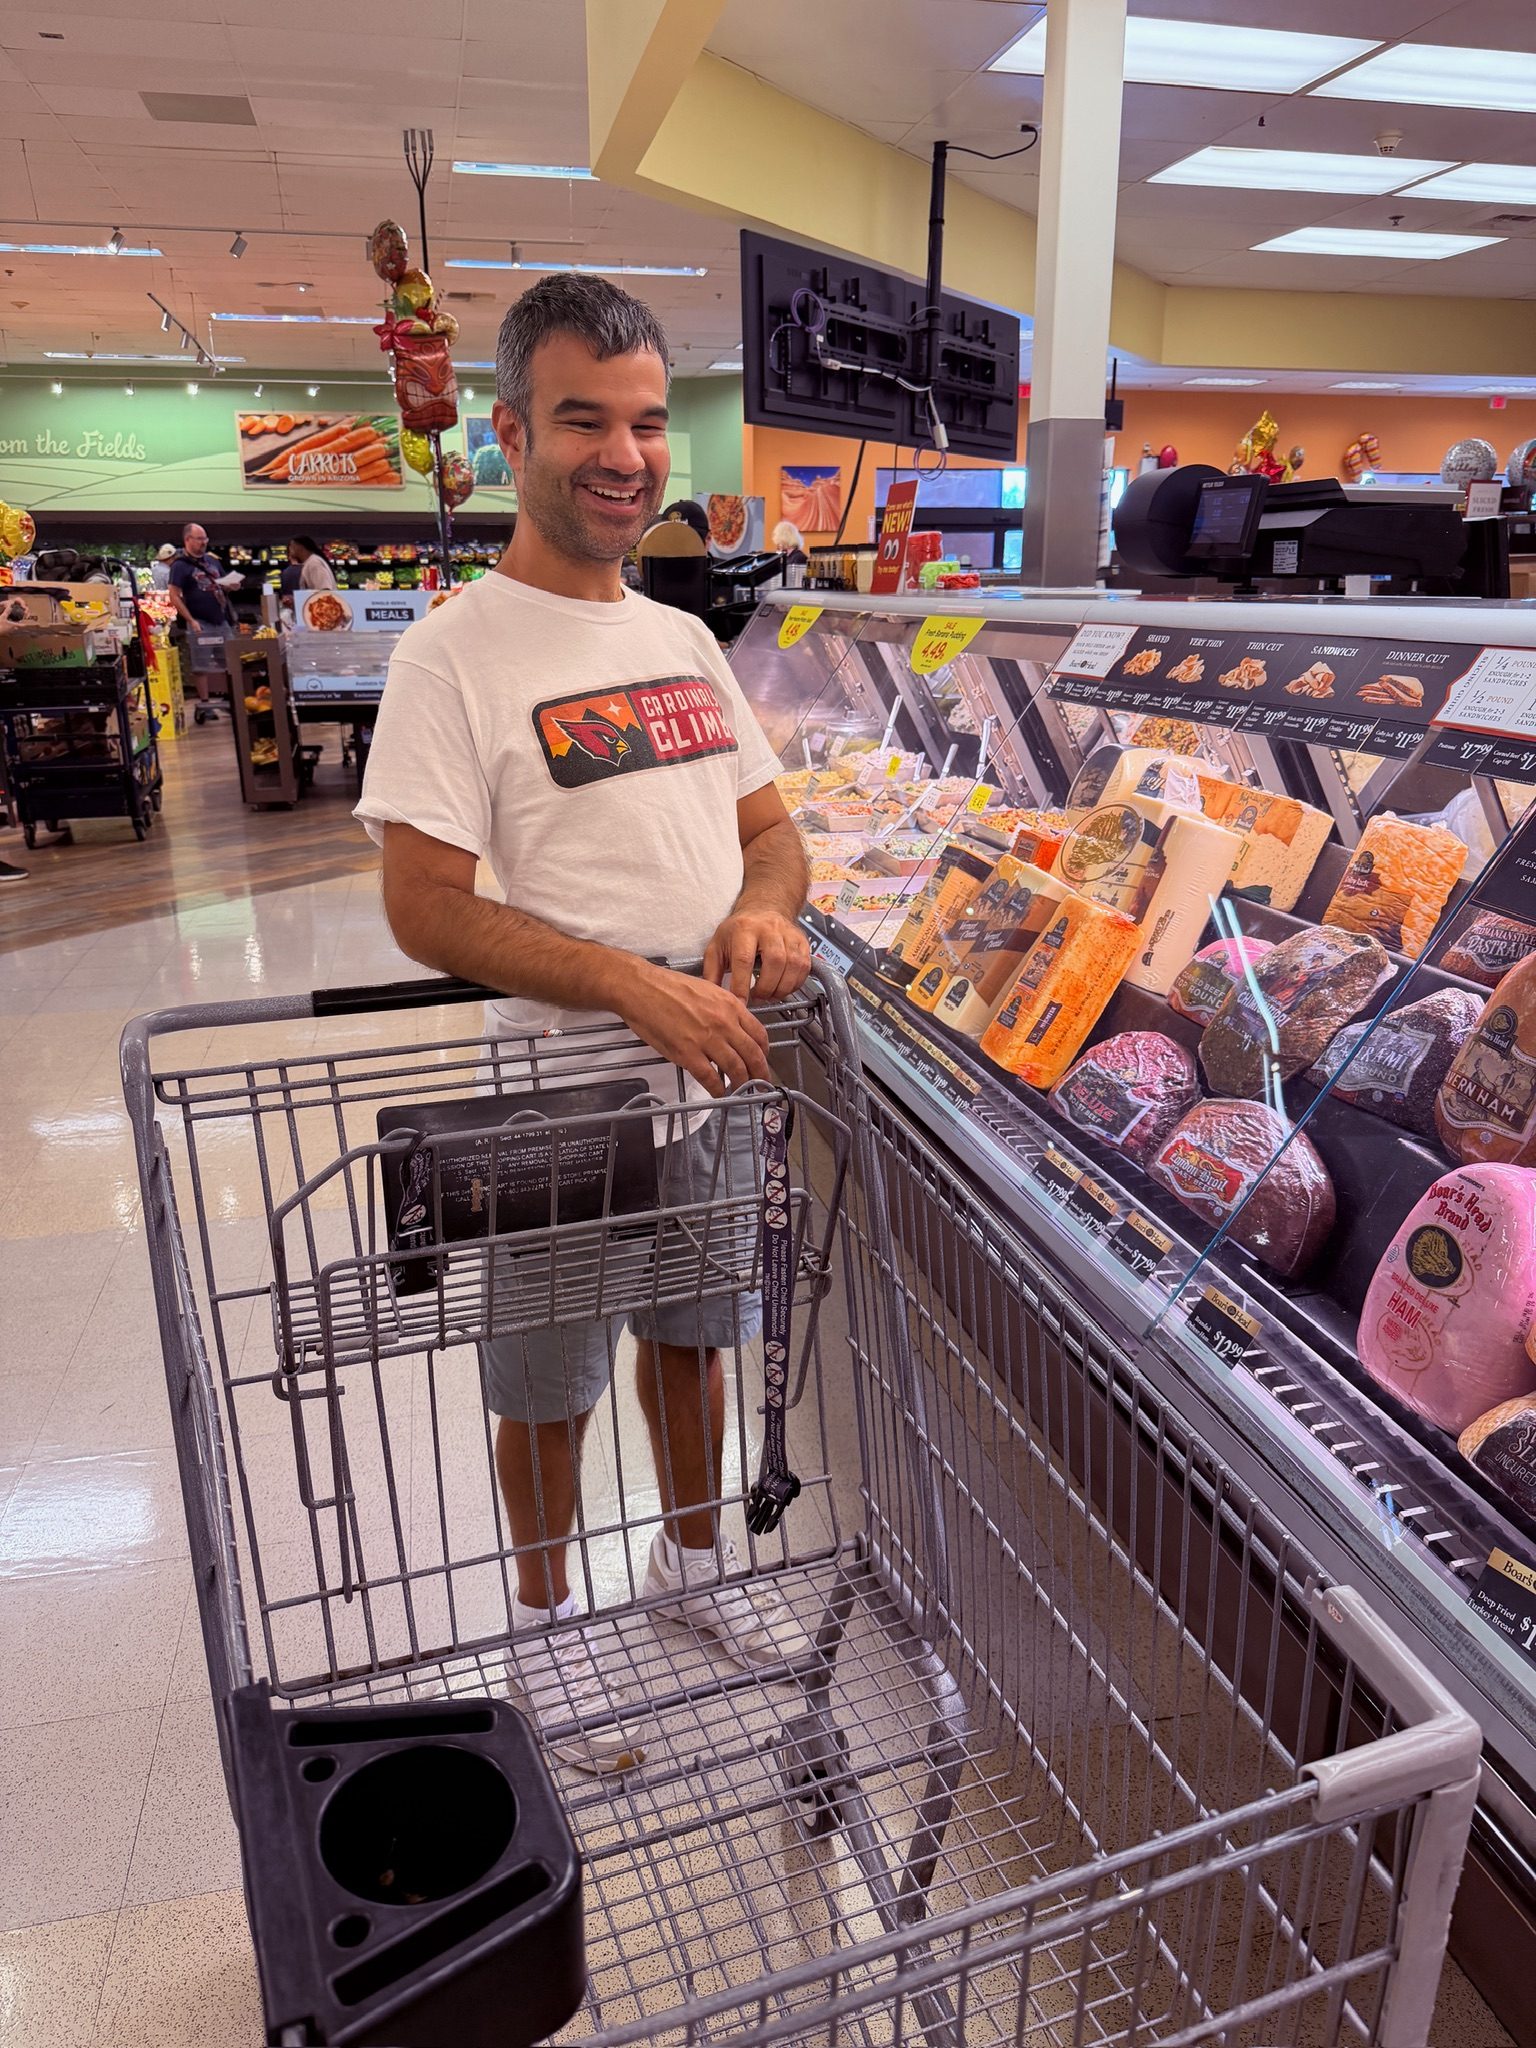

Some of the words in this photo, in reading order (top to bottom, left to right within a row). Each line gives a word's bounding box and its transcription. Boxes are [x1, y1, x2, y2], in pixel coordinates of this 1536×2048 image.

[0, 439, 28, 454] om
[35, 429, 71, 456] the
[76, 430, 146, 461] Fields
[288, 452, 358, 476] CARROTS
[882, 510, 911, 534] NEW!
[371, 610, 409, 620] MEALS
[1146, 634, 1170, 644] SHAVED
[1189, 637, 1206, 647] VERY
[1206, 638, 1225, 648] THIN
[1246, 641, 1266, 651] THIN
[1265, 643, 1284, 652] CUT
[1310, 646, 1359, 657] SANDWICH
[1386, 651, 1426, 662] DINNER
[1425, 653, 1450, 664] CUT
[1483, 677, 1528, 687] SANDWICHES
[640, 688, 719, 718] CARDINALS
[1486, 695, 1514, 705] POUND
[1458, 711, 1502, 722] SANDWICHES
[1203, 982, 1226, 999] BEEF
[1330, 1035, 1409, 1072] PATRAMI
[1070, 1080, 1119, 1123] DELUXE
[1445, 1070, 1476, 1097] VERN
[1476, 1089, 1517, 1123] HAM
[527, 1144, 553, 1153] PREMISE
[1170, 1152, 1199, 1177] London
[1199, 1168, 1229, 1192] Broil
[1426, 1182, 1466, 1204] Boar's
[1463, 1192, 1493, 1234] Head
[1434, 1200, 1470, 1231] Brand
[771, 1234, 779, 1245] Do
[779, 1305, 790, 1336] Securely
[1233, 1310, 1252, 1330] Head
[1386, 1289, 1423, 1330] HAM
[1495, 1450, 1536, 1486] UNCURED
[1502, 1560, 1534, 1587] Boar's
[1467, 1596, 1493, 1621] Turkey
[1491, 1615, 1515, 1636] Breast
[1477, 1590, 1496, 1609] Deep
[1496, 1603, 1517, 1621] Fried
[1519, 1615, 1536, 1651] $1
